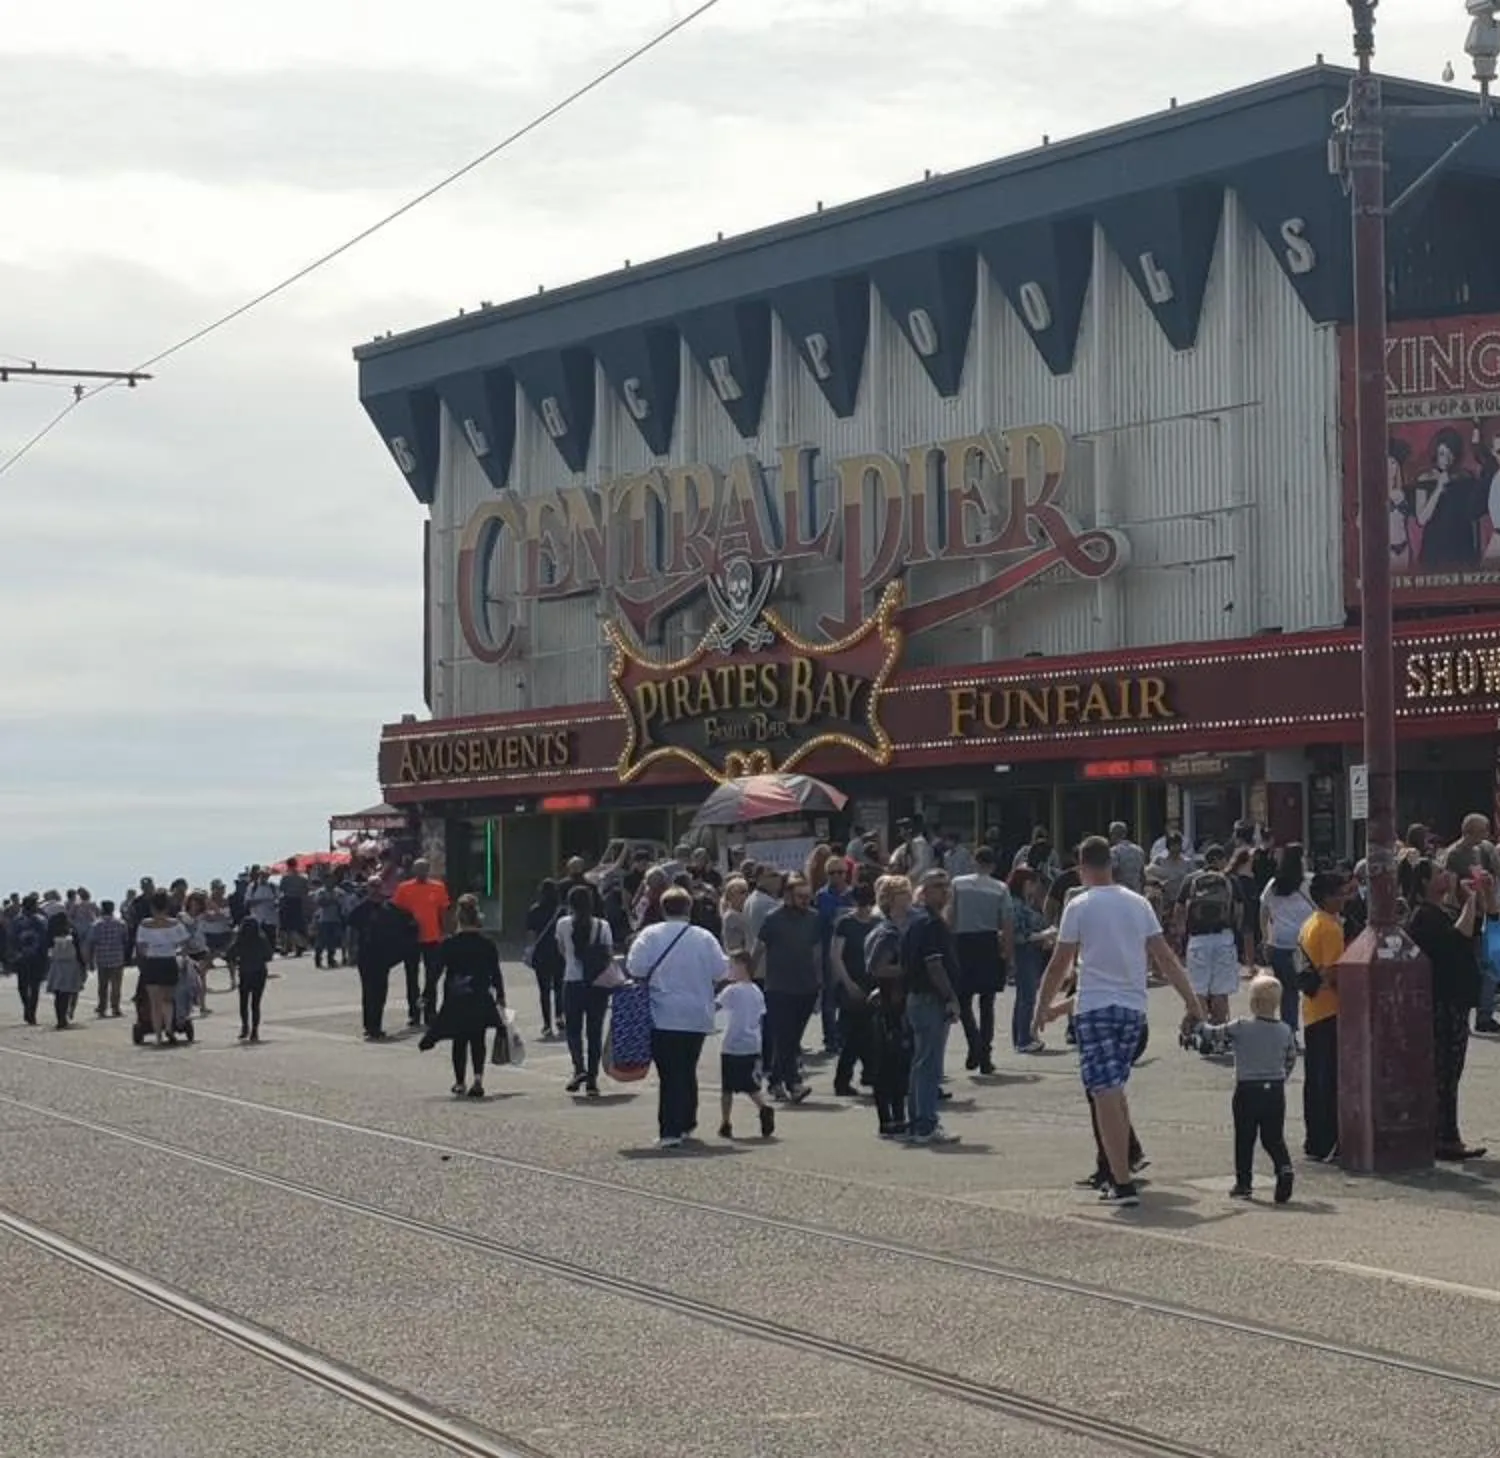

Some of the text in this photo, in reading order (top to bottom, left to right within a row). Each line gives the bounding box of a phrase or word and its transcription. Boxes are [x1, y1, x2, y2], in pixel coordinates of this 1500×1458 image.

[1429, 398, 1458, 417] POP
[457, 422, 1118, 664] CENTRAL PIER
[633, 656, 863, 748] PIRATES BAY
[753, 711, 791, 741] BAR
[947, 675, 1174, 738] FUNFAIR
[400, 731, 569, 782] AMUSEMENTS
